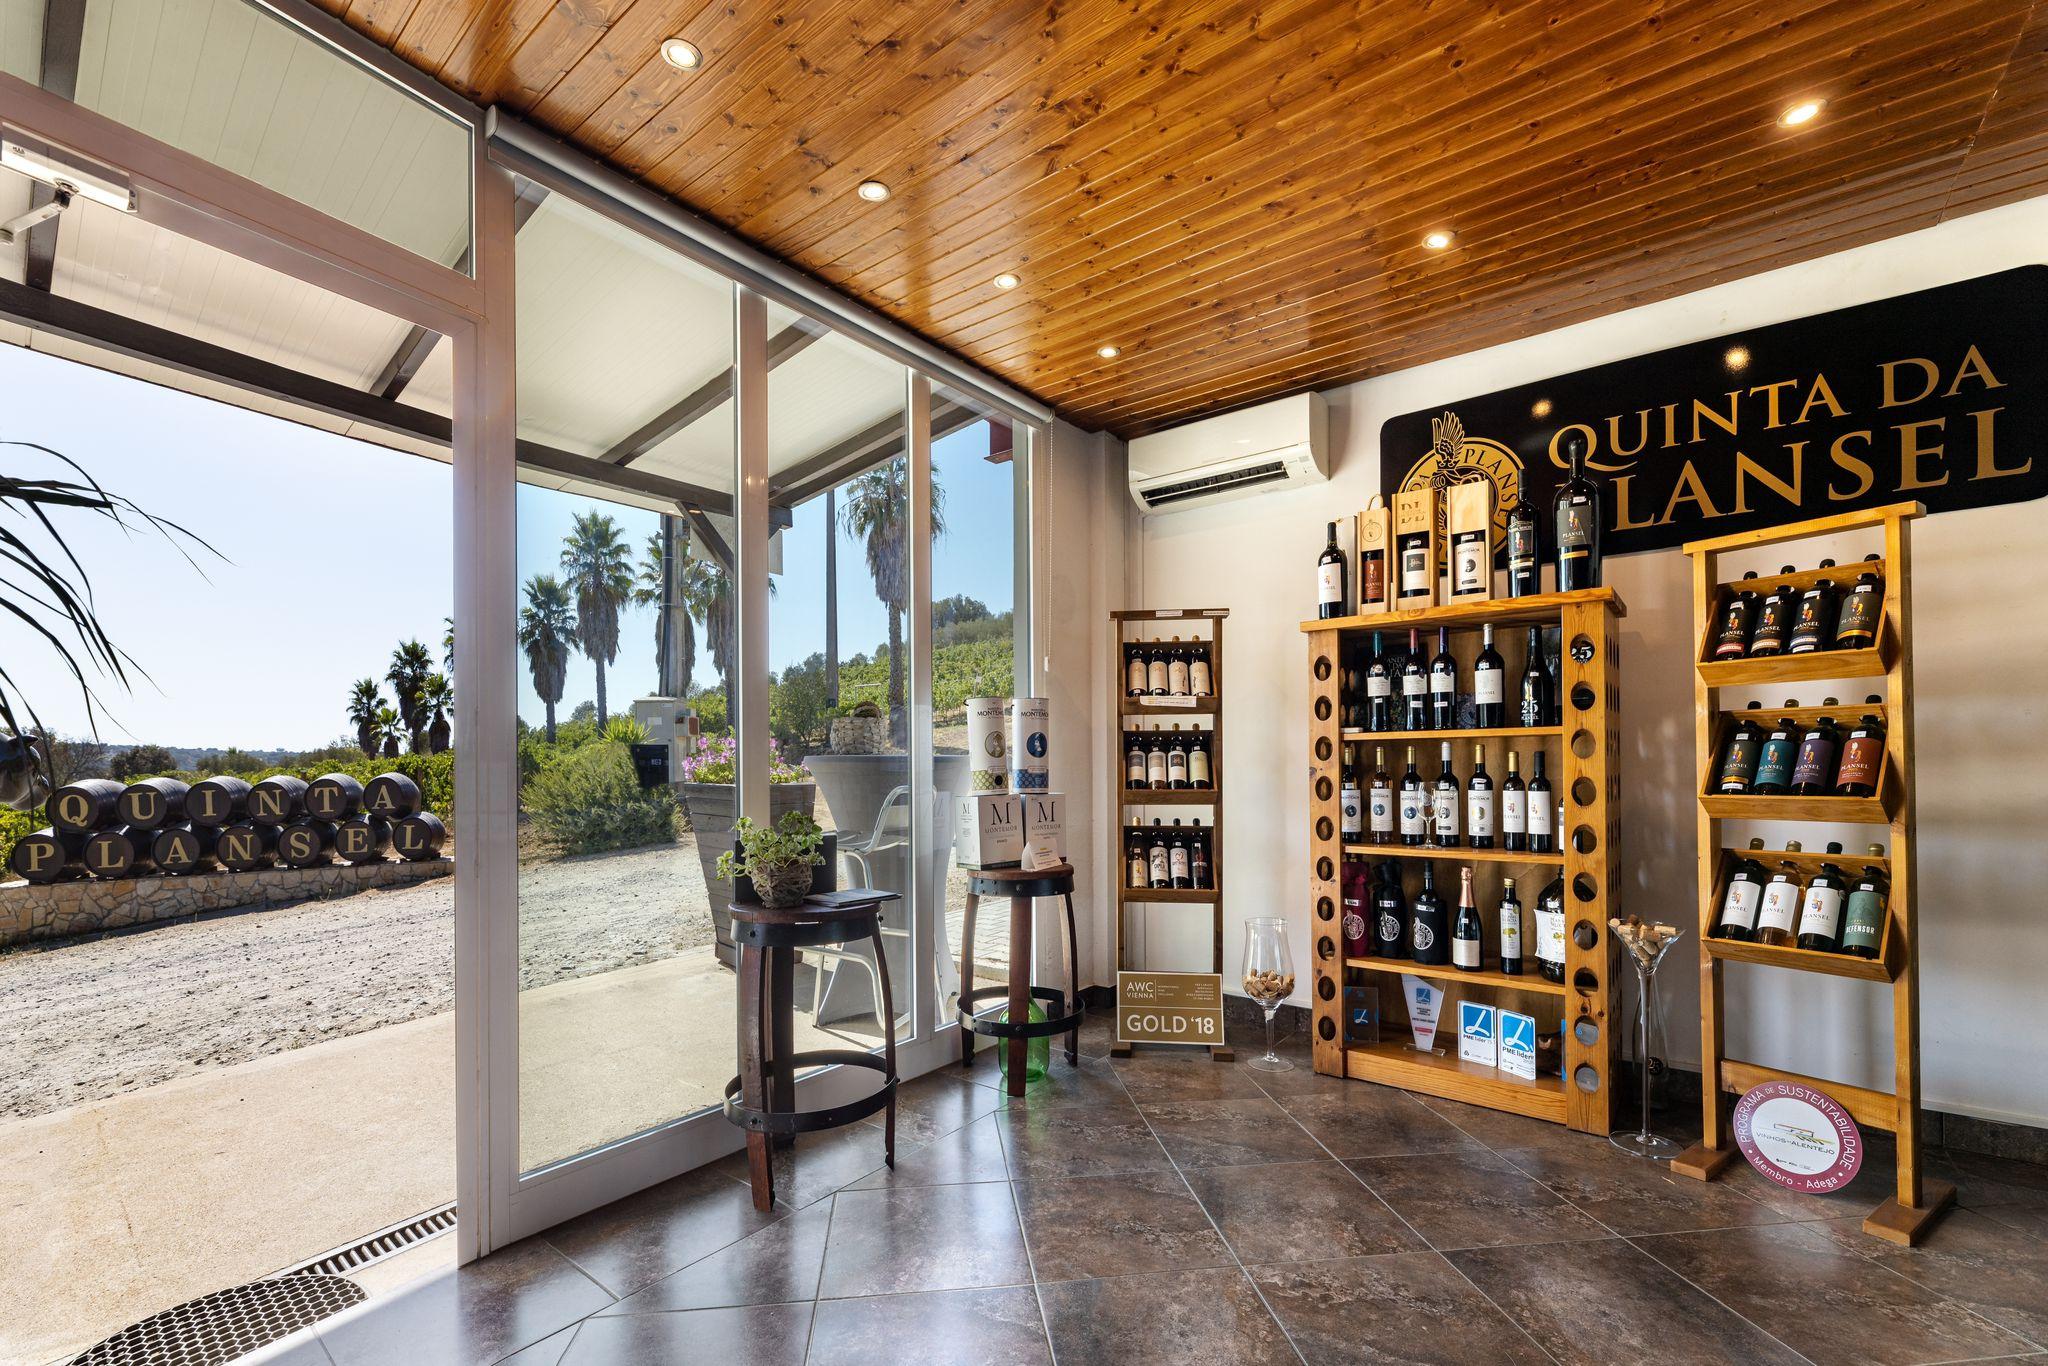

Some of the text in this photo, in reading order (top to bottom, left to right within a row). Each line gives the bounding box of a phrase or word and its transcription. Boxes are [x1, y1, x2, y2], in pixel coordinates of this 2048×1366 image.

[1548, 344, 2008, 471] QUINTA DA
[1554, 406, 2034, 532] LANSEL
[1755, 626, 1780, 635] PLANSEL
[1793, 621, 1820, 631] PLANSEL
[1521, 700, 1539, 714] 25
[1840, 763, 1869, 771] PLANSEL
[59, 784, 396, 827] QUINTA
[991, 802, 1011, 825] M
[1038, 801, 1055, 823] M
[26, 824, 427, 873] PLANSEL
[1126, 981, 1154, 992] AWC
[1126, 1014, 1187, 1034] GOLD
[1502, 1046, 1516, 1056] PME
[1736, 1085, 1857, 1171] PROGRAMA DE SUSTENTABILIDADE
[1756, 1131, 1787, 1144] VINHOS
[1790, 1139, 1835, 1156] ALENTEJO
[1753, 1155, 1794, 1185] Membro
[1806, 1176, 1838, 1190] Adega
